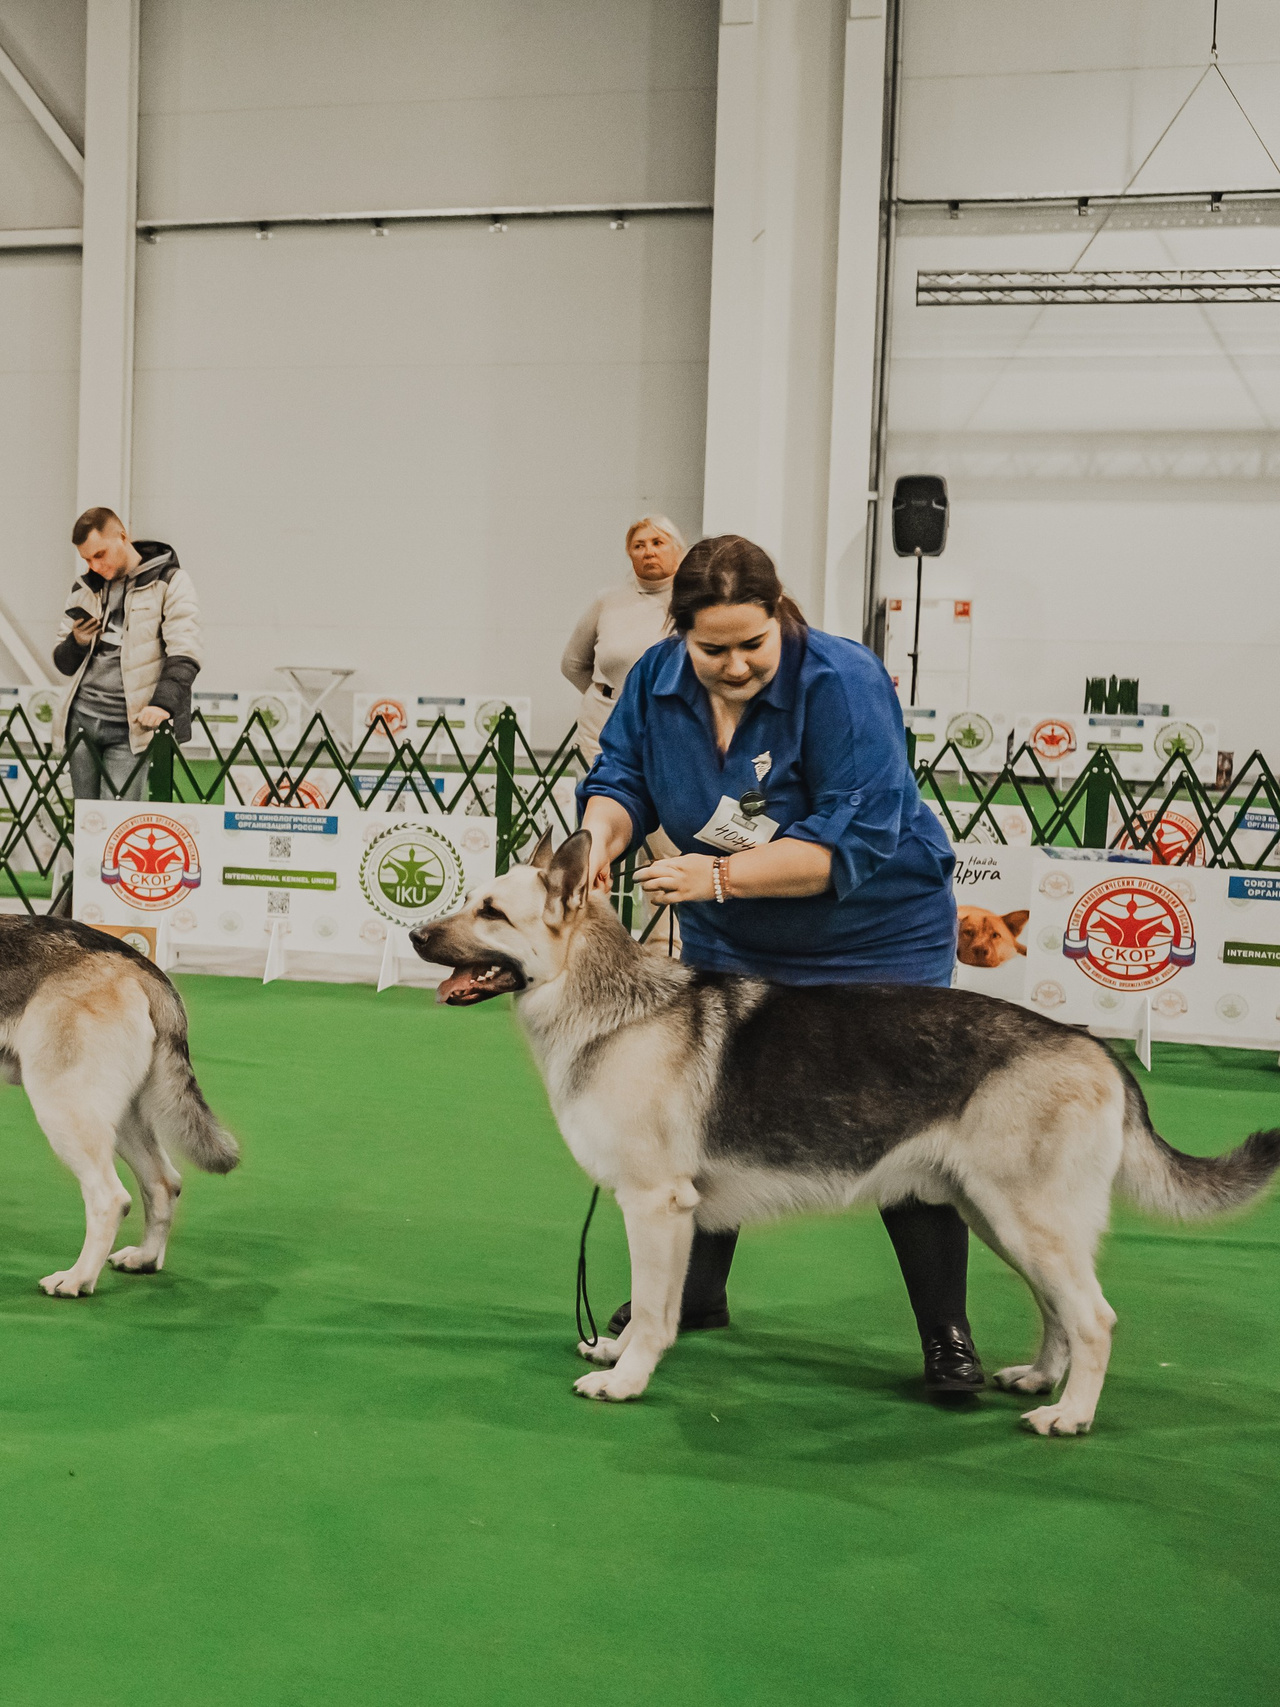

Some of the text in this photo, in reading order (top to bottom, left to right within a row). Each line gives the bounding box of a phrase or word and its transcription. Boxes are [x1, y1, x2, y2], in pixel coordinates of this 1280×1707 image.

[235, 813, 257, 821] СОЮЗ
[238, 821, 324, 832] ОРГАНИЗАЦИЙ РОССИИ
[130, 873, 171, 886] СКОР
[224, 872, 334, 885] INTERNATIONAL KENNEL UNION
[953, 861, 1001, 885] Друга
[1244, 879, 1273, 888] СОЮЗ
[396, 886, 427, 904] IKU
[1102, 946, 1156, 962] СКОР
